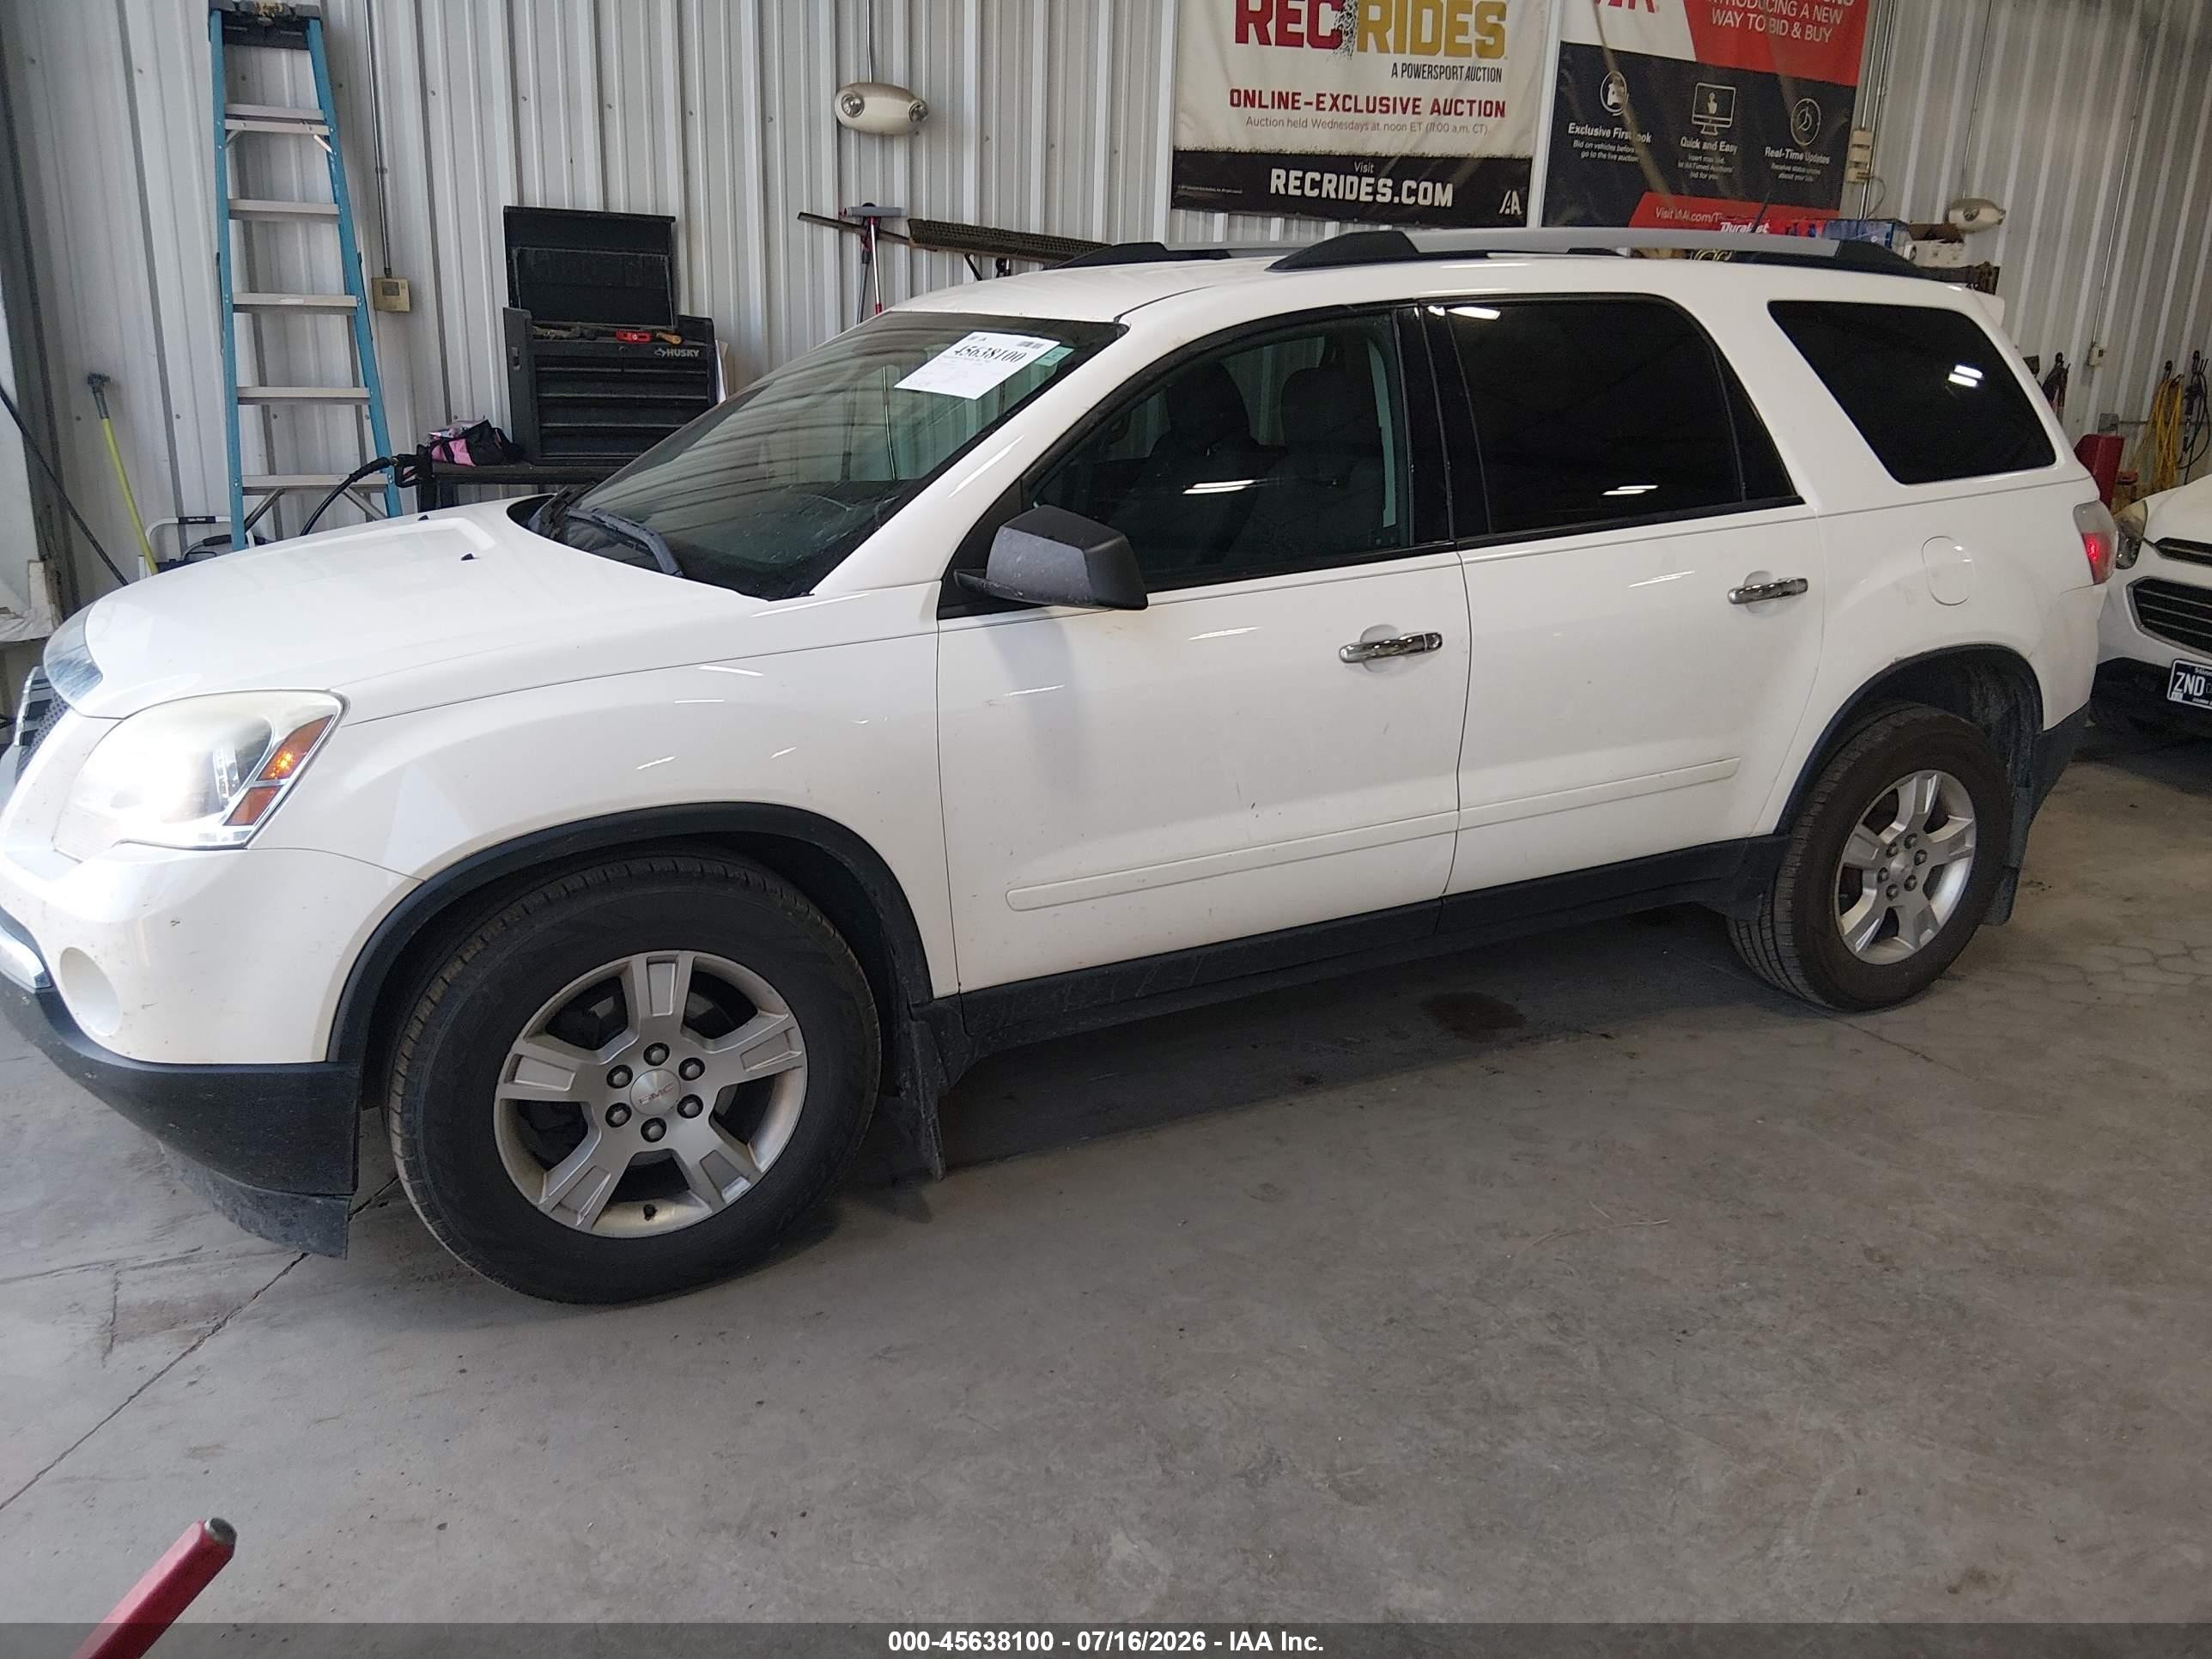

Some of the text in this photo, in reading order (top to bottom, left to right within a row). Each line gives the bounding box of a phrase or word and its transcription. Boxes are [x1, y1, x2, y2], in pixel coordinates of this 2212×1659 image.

[1799, 3, 1809, 19] A
[1813, 5, 1844, 25] NEW
[1711, 7, 1833, 43] WAY TO BID & BUY
[1390, 62, 1503, 82] A POWERSPORT AUCTION
[1230, 88, 1506, 118] ONLINE-EXCLUSIVE AUCTION
[1246, 116, 1284, 128] Auction
[1287, 117, 1308, 128] held
[1310, 118, 1369, 132] Wednesdays
[1370, 122, 1381, 131] at
[1383, 123, 1407, 131] noon
[1410, 122, 1422, 131] ET
[1567, 122, 1611, 137] Exclusive
[1680, 136, 1738, 155] Quick and Easy
[1765, 146, 1830, 164] Real-Time Updates
[1353, 161, 1374, 173] Visit
[1269, 168, 1454, 208] RECRIDES.COM
[1656, 207, 1674, 219] Visit
[666, 348, 700, 357] HUSKY
[955, 345, 1027, 363] 45638100
